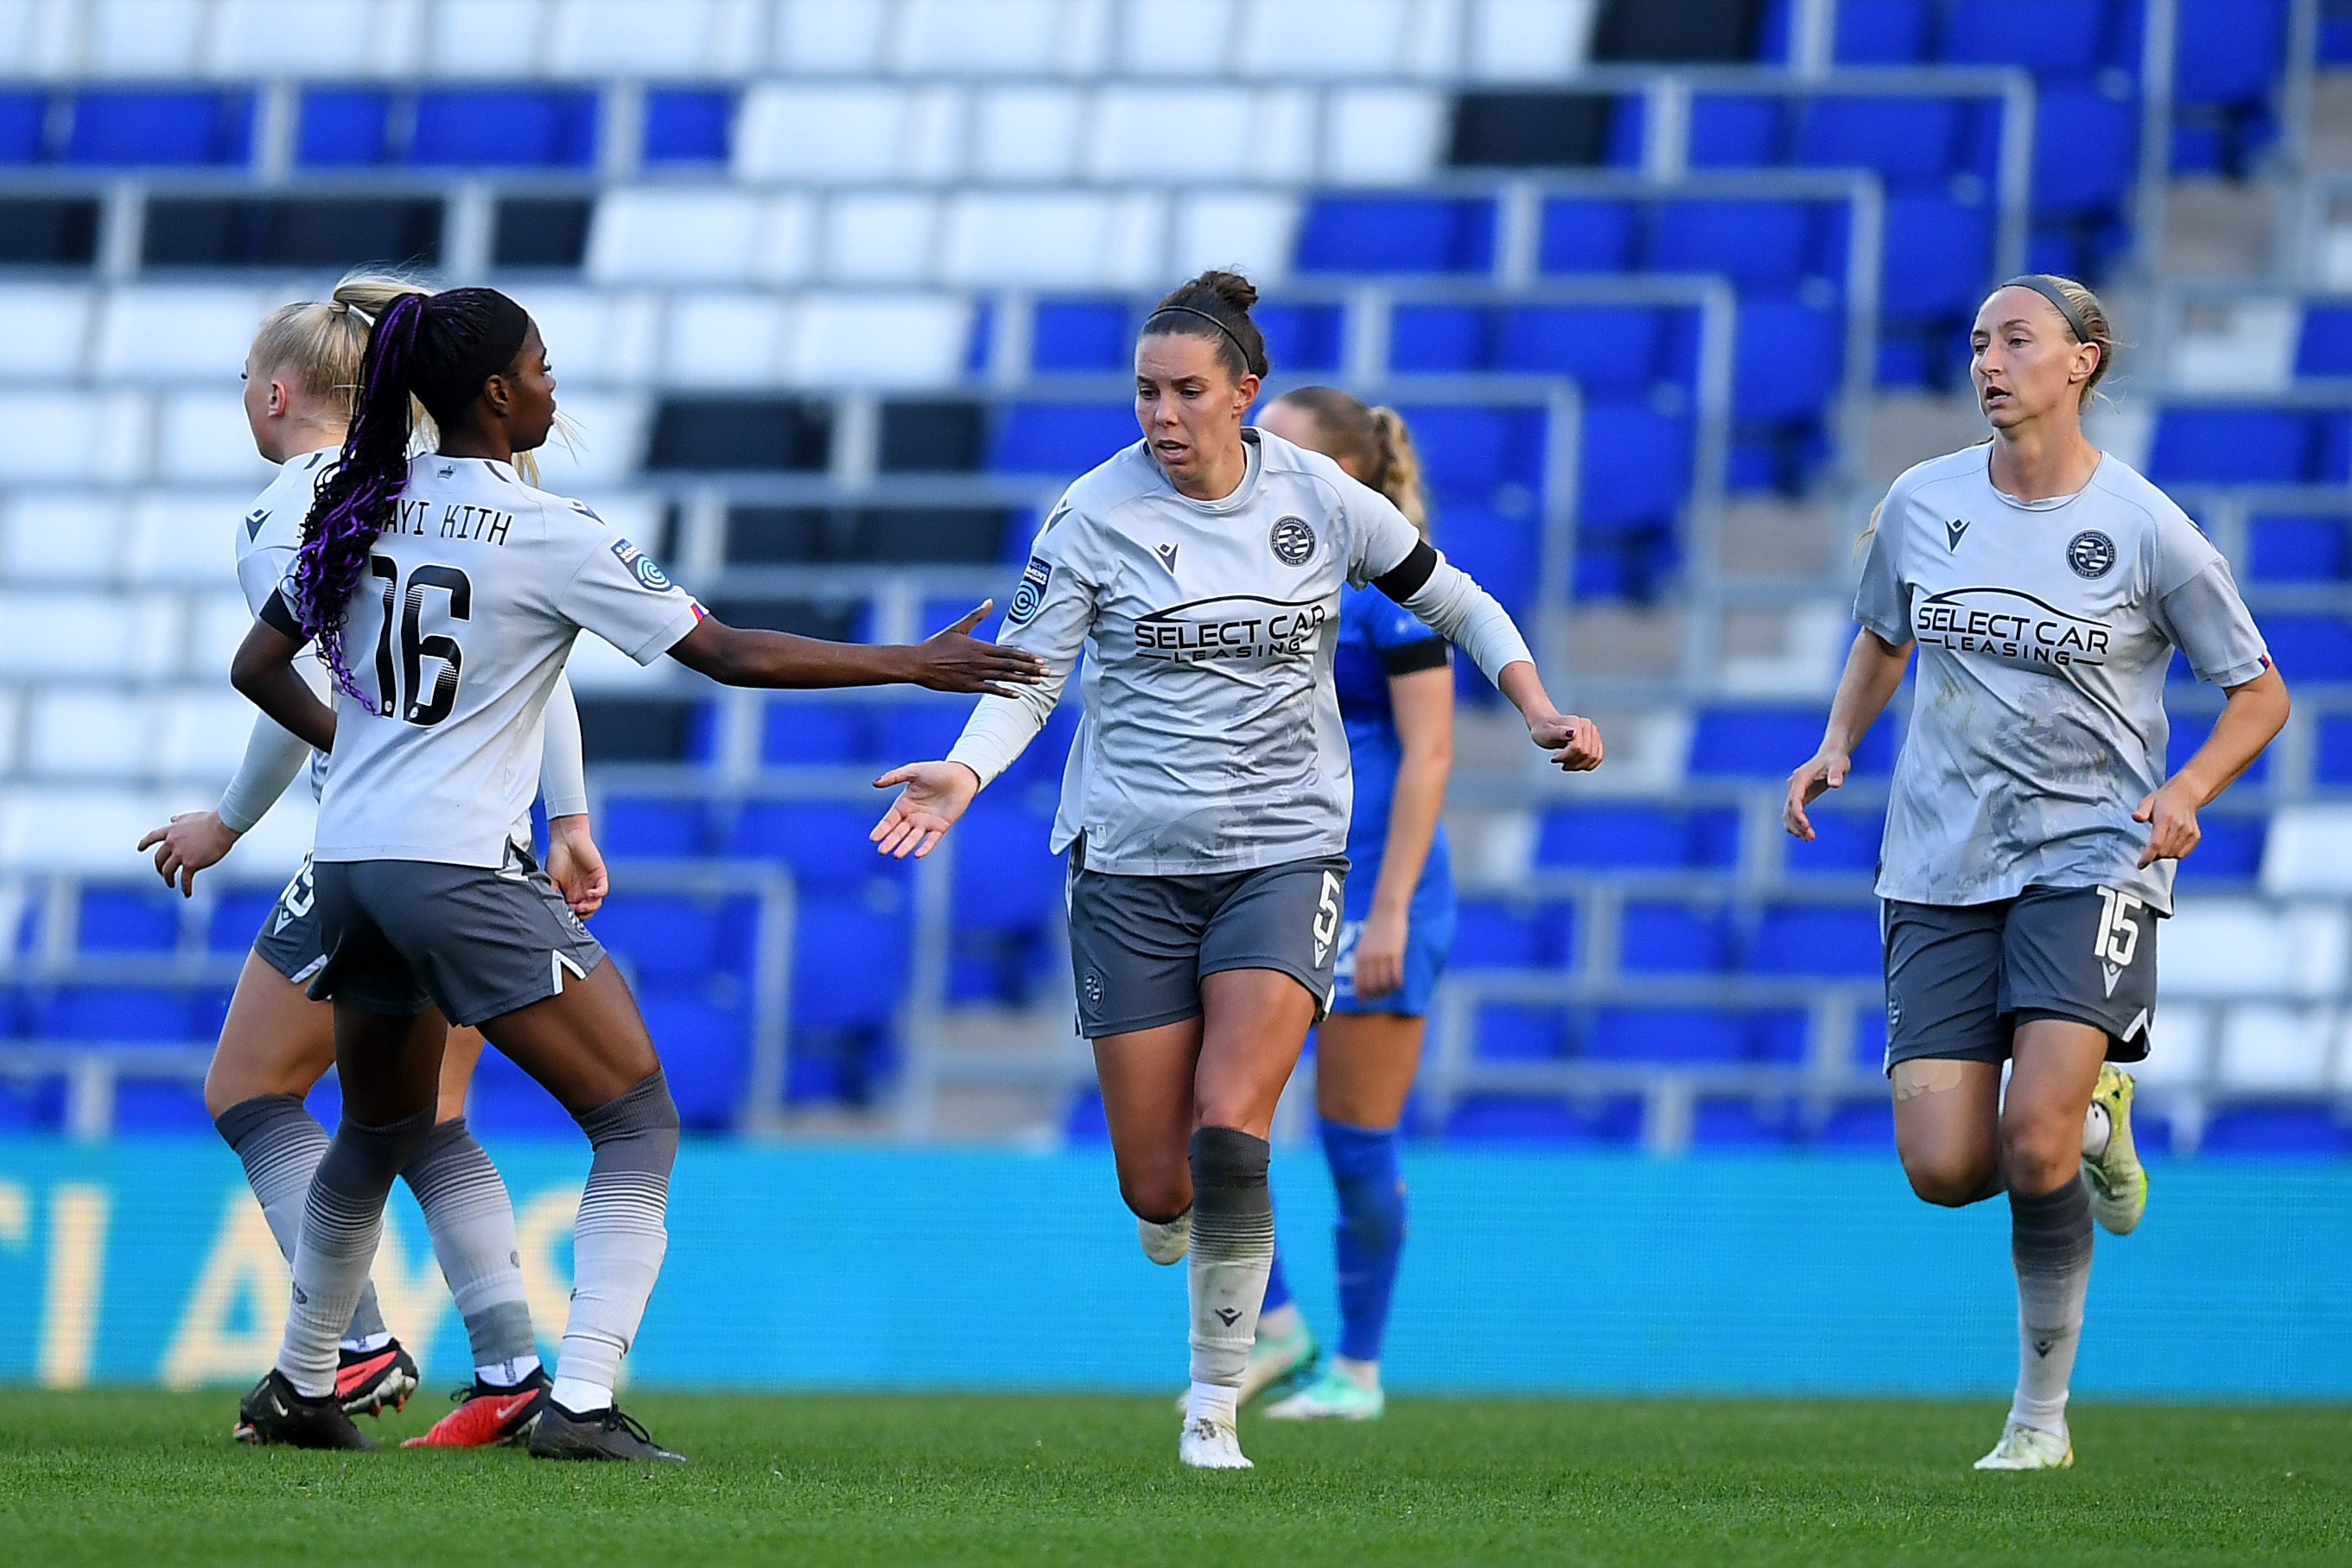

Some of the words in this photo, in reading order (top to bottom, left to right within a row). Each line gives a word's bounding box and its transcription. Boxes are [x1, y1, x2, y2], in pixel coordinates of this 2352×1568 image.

[383, 498, 430, 536] AYI
[440, 505, 513, 546] KITH
[369, 554, 474, 727] 16
[1134, 619, 1262, 650] SELECT
[1268, 604, 1326, 640] CAR
[1173, 636, 1302, 664] LEASING
[1917, 606, 2031, 641] SELECT
[2035, 621, 2110, 655] CAR
[1944, 634, 2071, 666] LEASING
[1313, 869, 1340, 946] 5
[2094, 884, 2142, 967] 15
